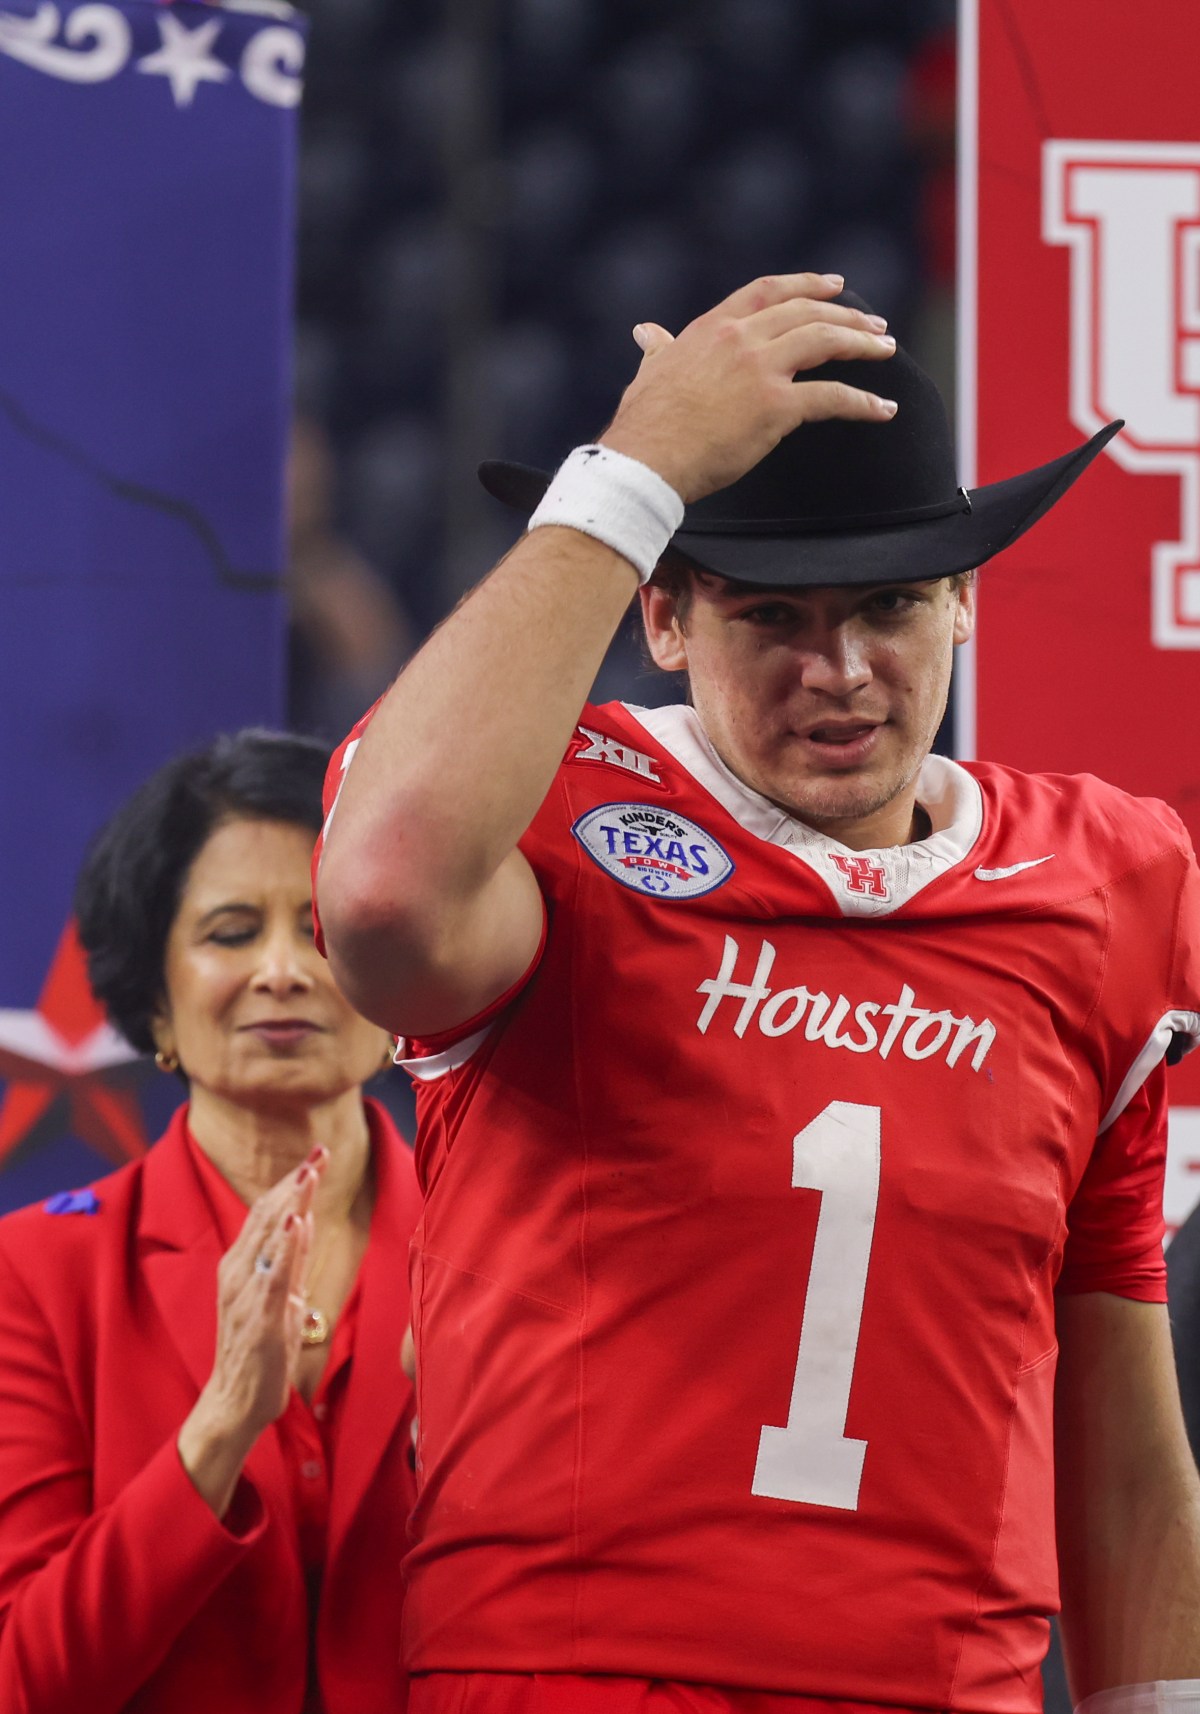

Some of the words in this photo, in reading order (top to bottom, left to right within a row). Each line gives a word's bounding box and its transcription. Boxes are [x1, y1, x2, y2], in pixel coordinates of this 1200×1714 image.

[575, 725, 661, 784] XII
[600, 825, 710, 876] TEXAS
[618, 811, 686, 838] KINDER'S
[629, 857, 681, 874] BOWL
[696, 933, 998, 1073] Houston
[751, 1100, 882, 1511] 1
